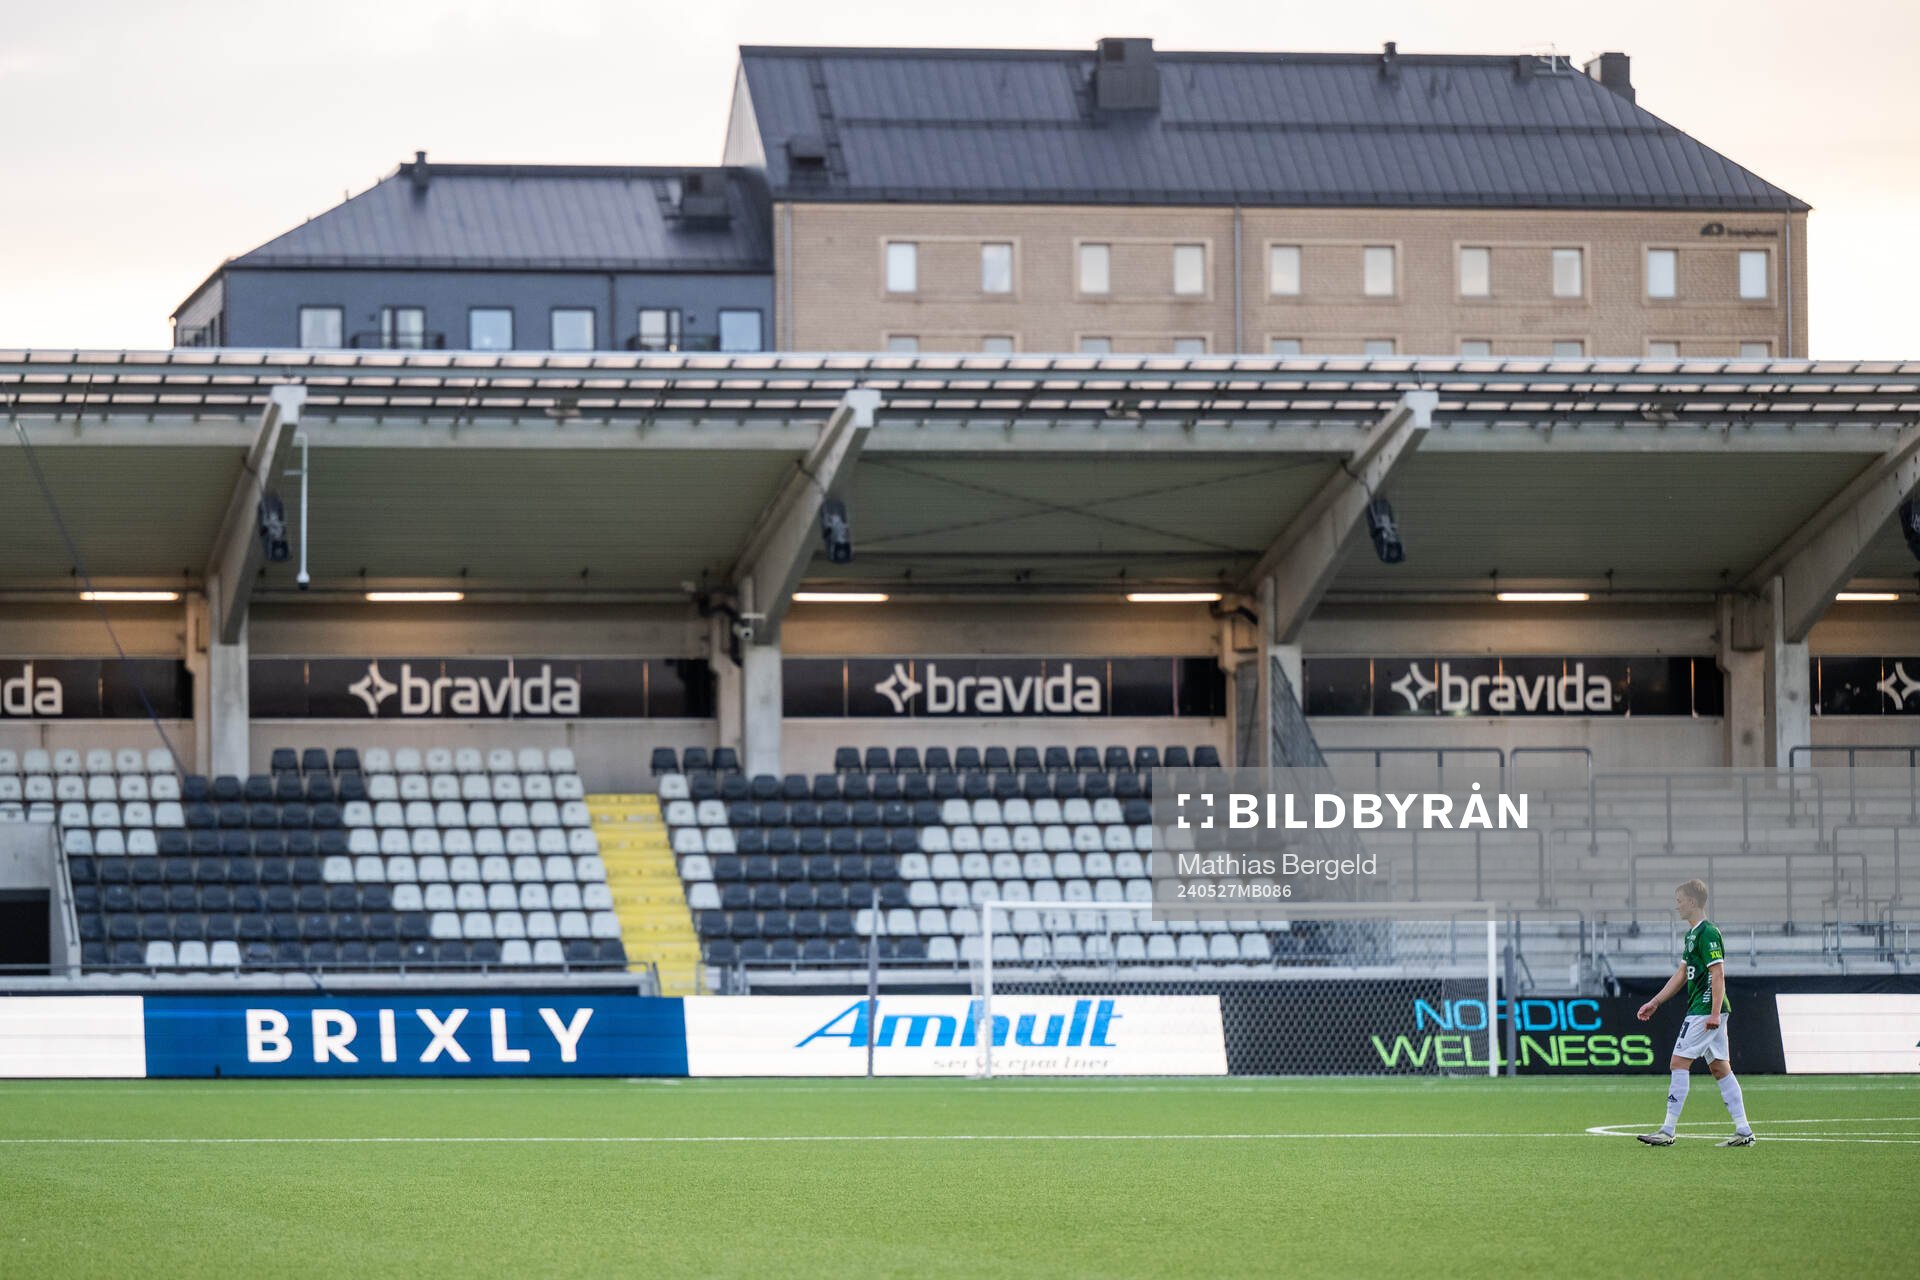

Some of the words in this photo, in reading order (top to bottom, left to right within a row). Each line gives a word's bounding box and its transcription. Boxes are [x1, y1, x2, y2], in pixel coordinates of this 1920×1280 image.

[0, 664, 63, 715] da
[401, 663, 581, 715] bravida
[926, 663, 1101, 713] bravida
[1441, 662, 1612, 712] bravida
[246, 1008, 594, 1063] BRIXLY
[794, 999, 1123, 1048] Amhult
[1371, 1035, 1655, 1067] WELLNESS
